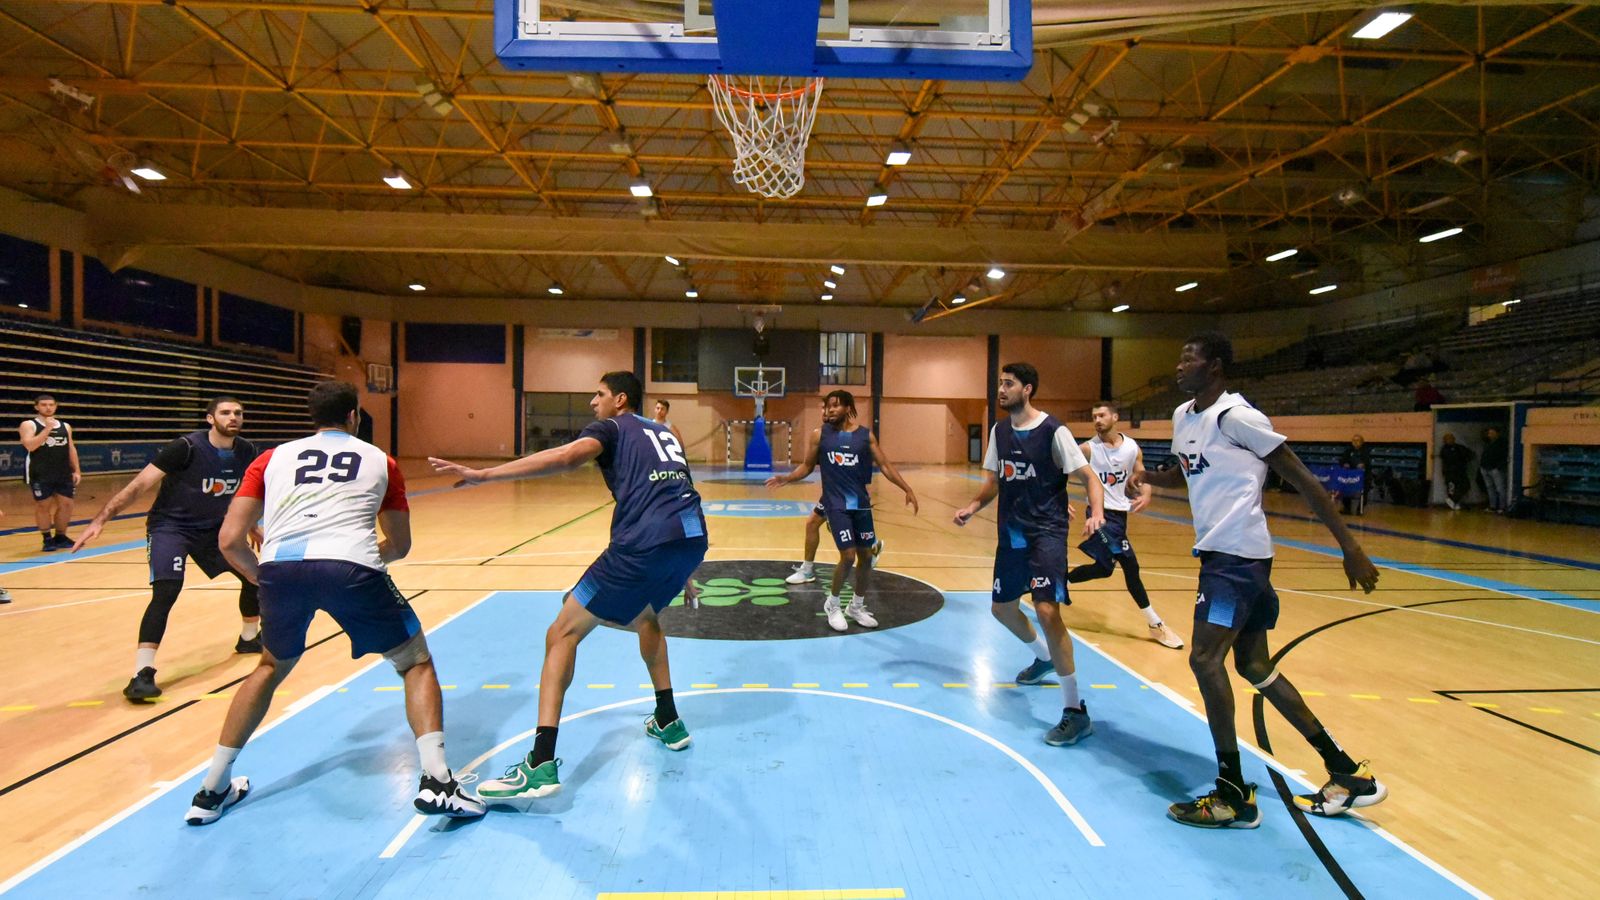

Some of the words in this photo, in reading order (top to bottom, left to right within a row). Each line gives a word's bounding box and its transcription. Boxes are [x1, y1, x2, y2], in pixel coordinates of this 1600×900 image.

[41, 437, 68, 447] DEA
[643, 428, 687, 466] 12
[827, 451, 859, 467] UDEA
[295, 449, 362, 486] 29
[840, 529, 852, 542] 21
[1122, 540, 1129, 550] 5
[173, 556, 182, 571] 2
[1030, 577, 1050, 589] DEA
